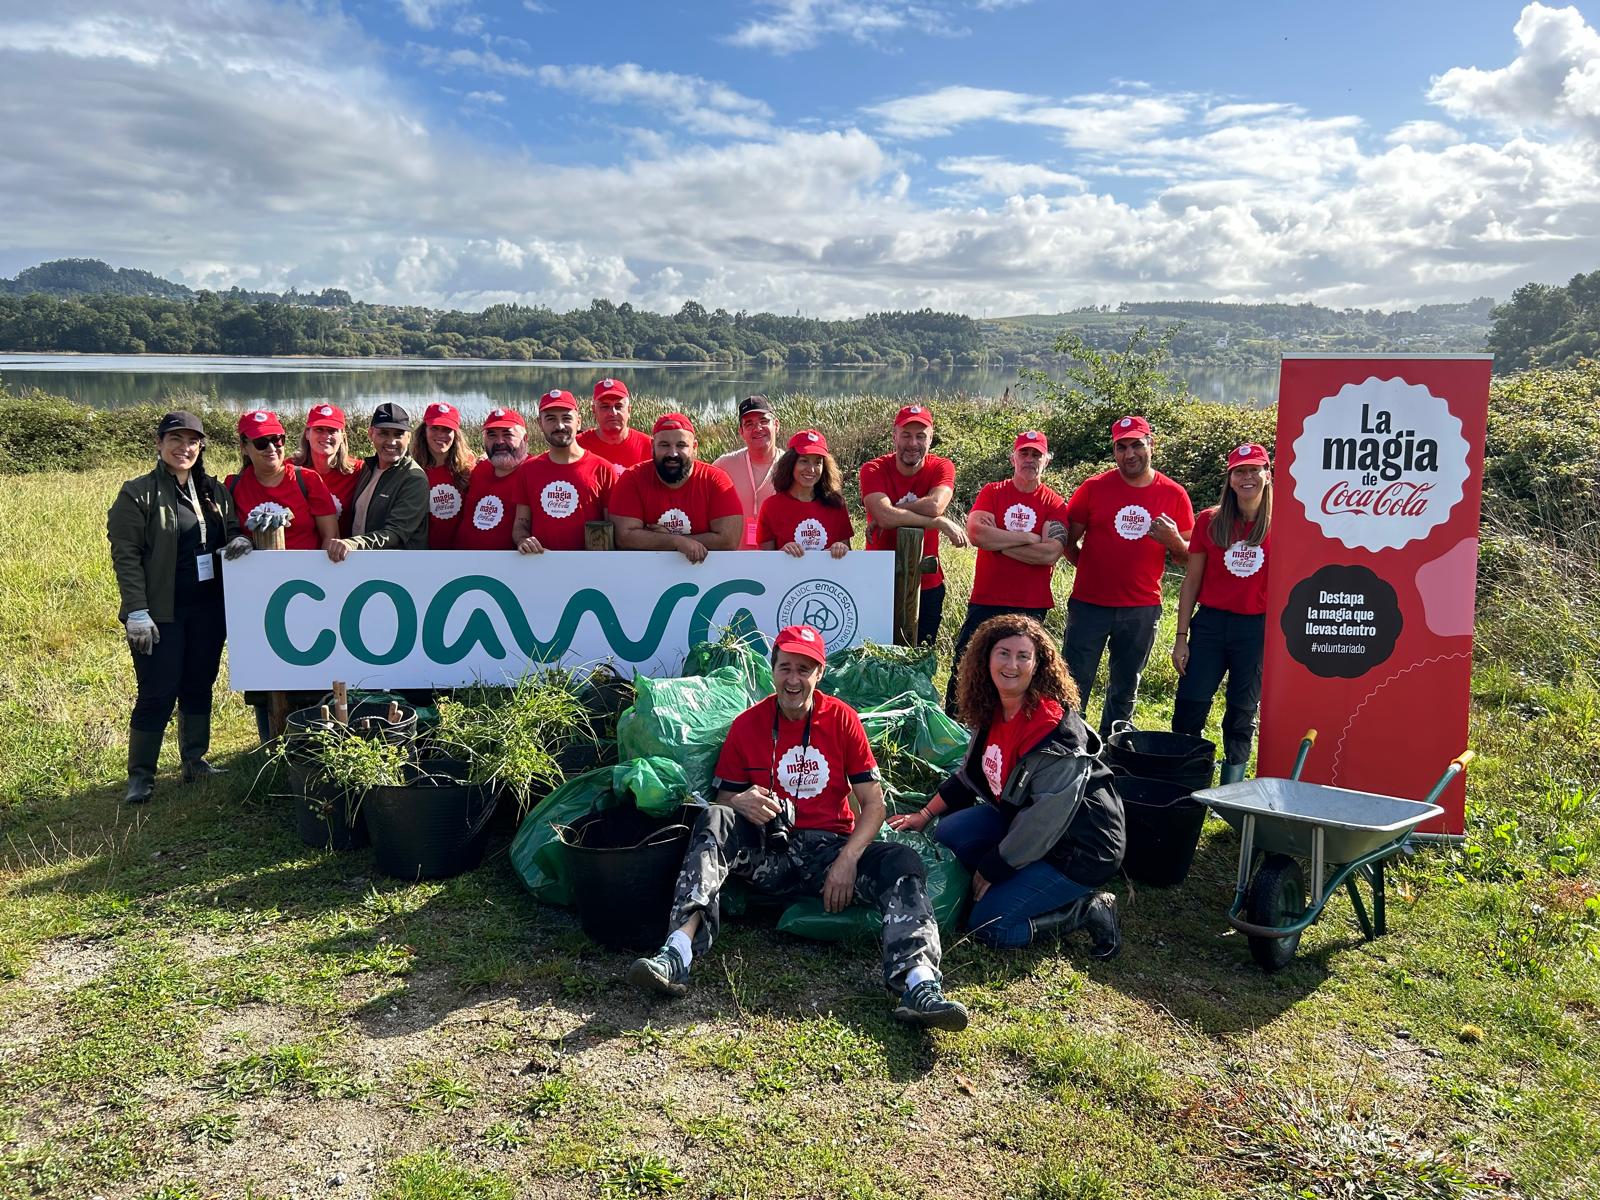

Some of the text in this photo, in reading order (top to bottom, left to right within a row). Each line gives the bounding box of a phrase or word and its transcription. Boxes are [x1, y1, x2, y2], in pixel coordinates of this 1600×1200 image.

[1361, 403, 1391, 434] La
[1322, 430, 1438, 481] magia
[1362, 472, 1377, 486] de
[433, 492, 454, 503] magia
[547, 491, 571, 501] magia
[1321, 481, 1437, 516] Coca-Cola
[479, 504, 498, 515] magia
[1011, 512, 1030, 521] magia
[1122, 515, 1145, 524] magia
[1232, 550, 1257, 560] magia
[795, 585, 811, 597] UDC
[815, 583, 850, 609] emalcsa
[1319, 590, 1364, 607] Destapa
[1307, 607, 1374, 623] la magia que
[1305, 622, 1376, 636] llevas dentro
[1311, 643, 1365, 654] #voluntariado
[795, 753, 804, 762] La
[786, 759, 819, 775] magia
